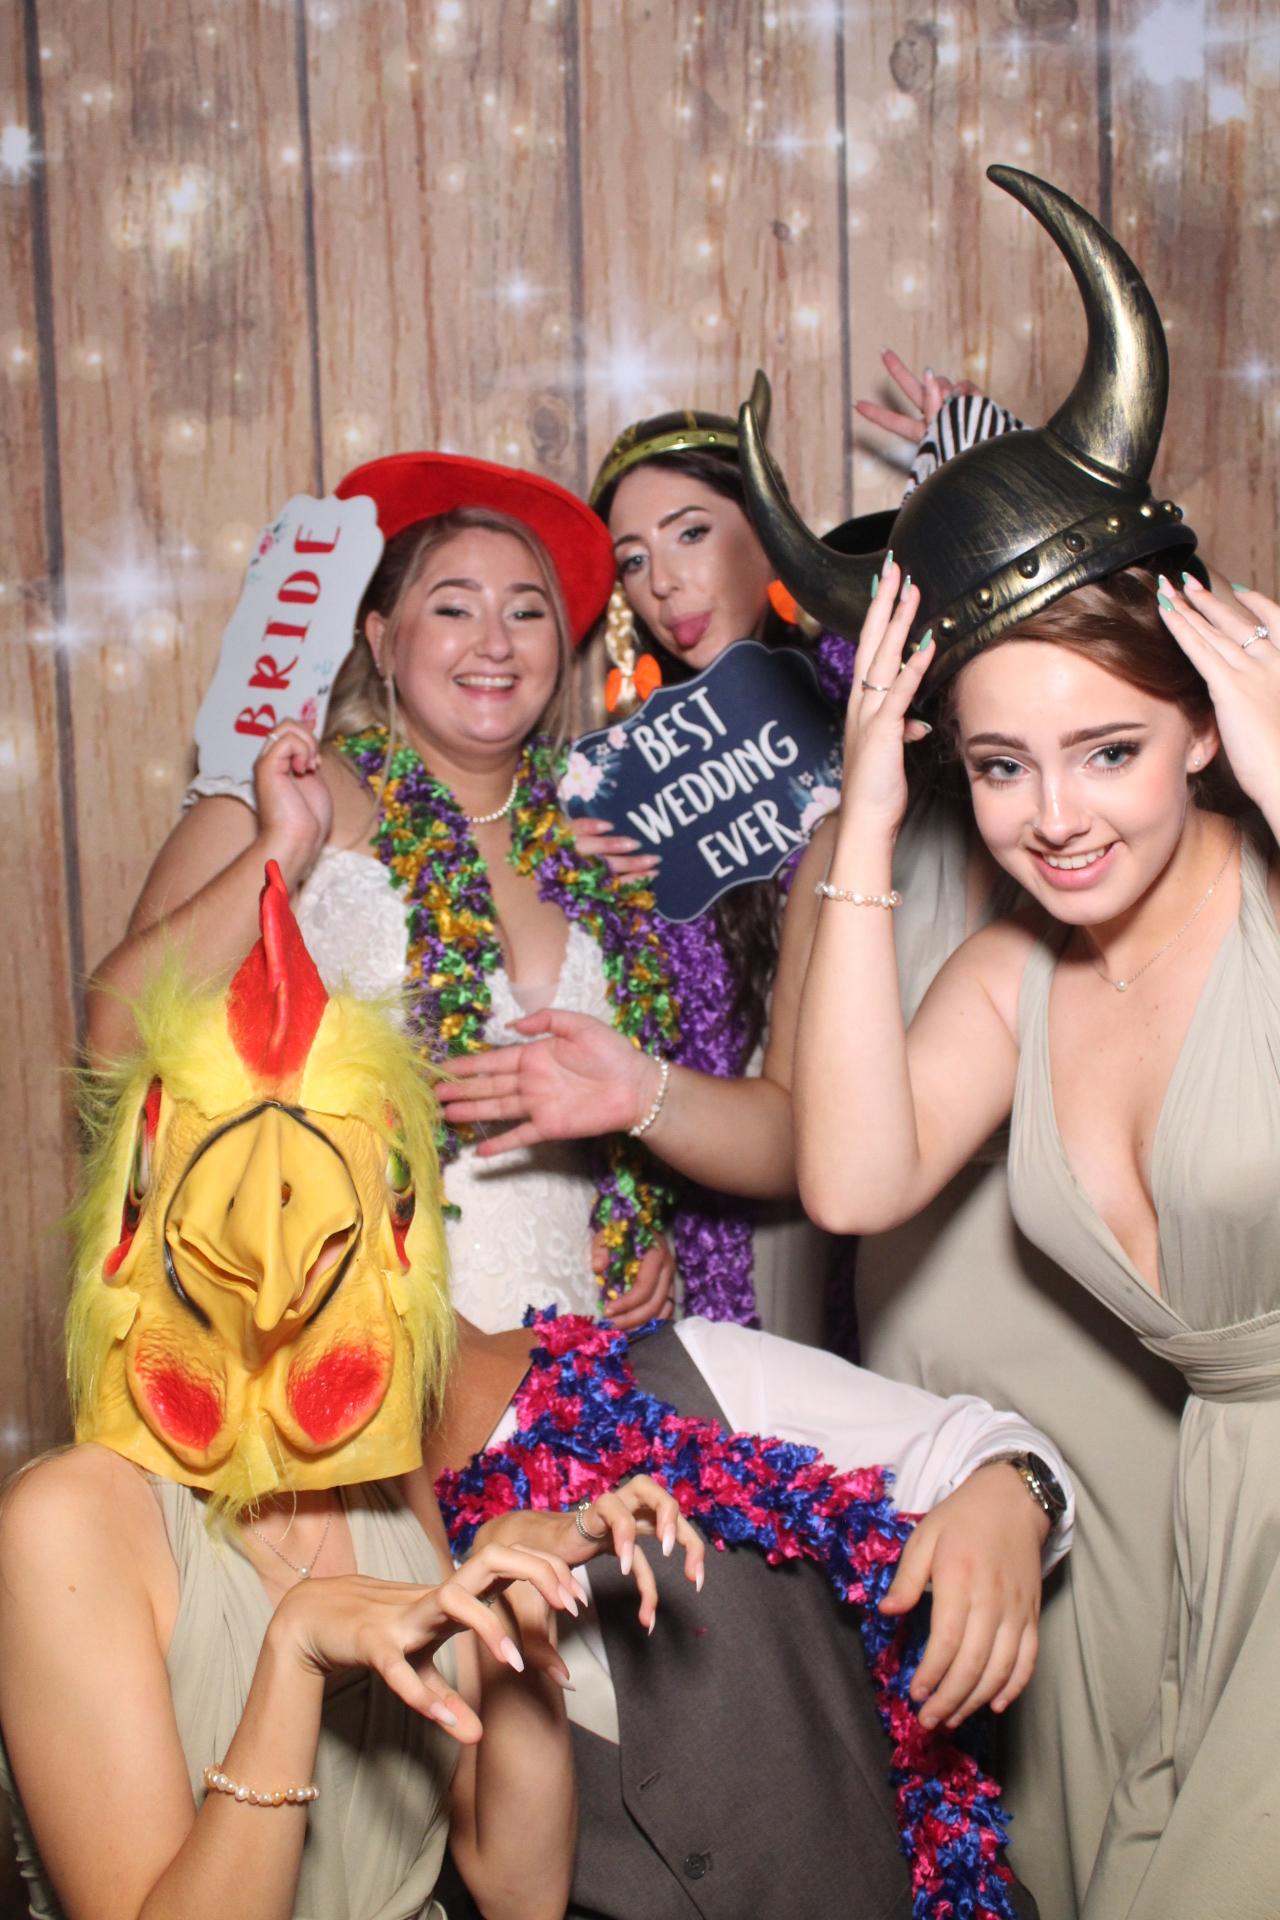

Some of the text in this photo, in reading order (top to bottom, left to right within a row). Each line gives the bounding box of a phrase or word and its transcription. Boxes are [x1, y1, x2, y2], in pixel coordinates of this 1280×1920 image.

[234, 524, 341, 737] BRIDE
[626, 720, 799, 845] WEDDING
[632, 686, 727, 773] BEST
[698, 800, 803, 878] EVER
